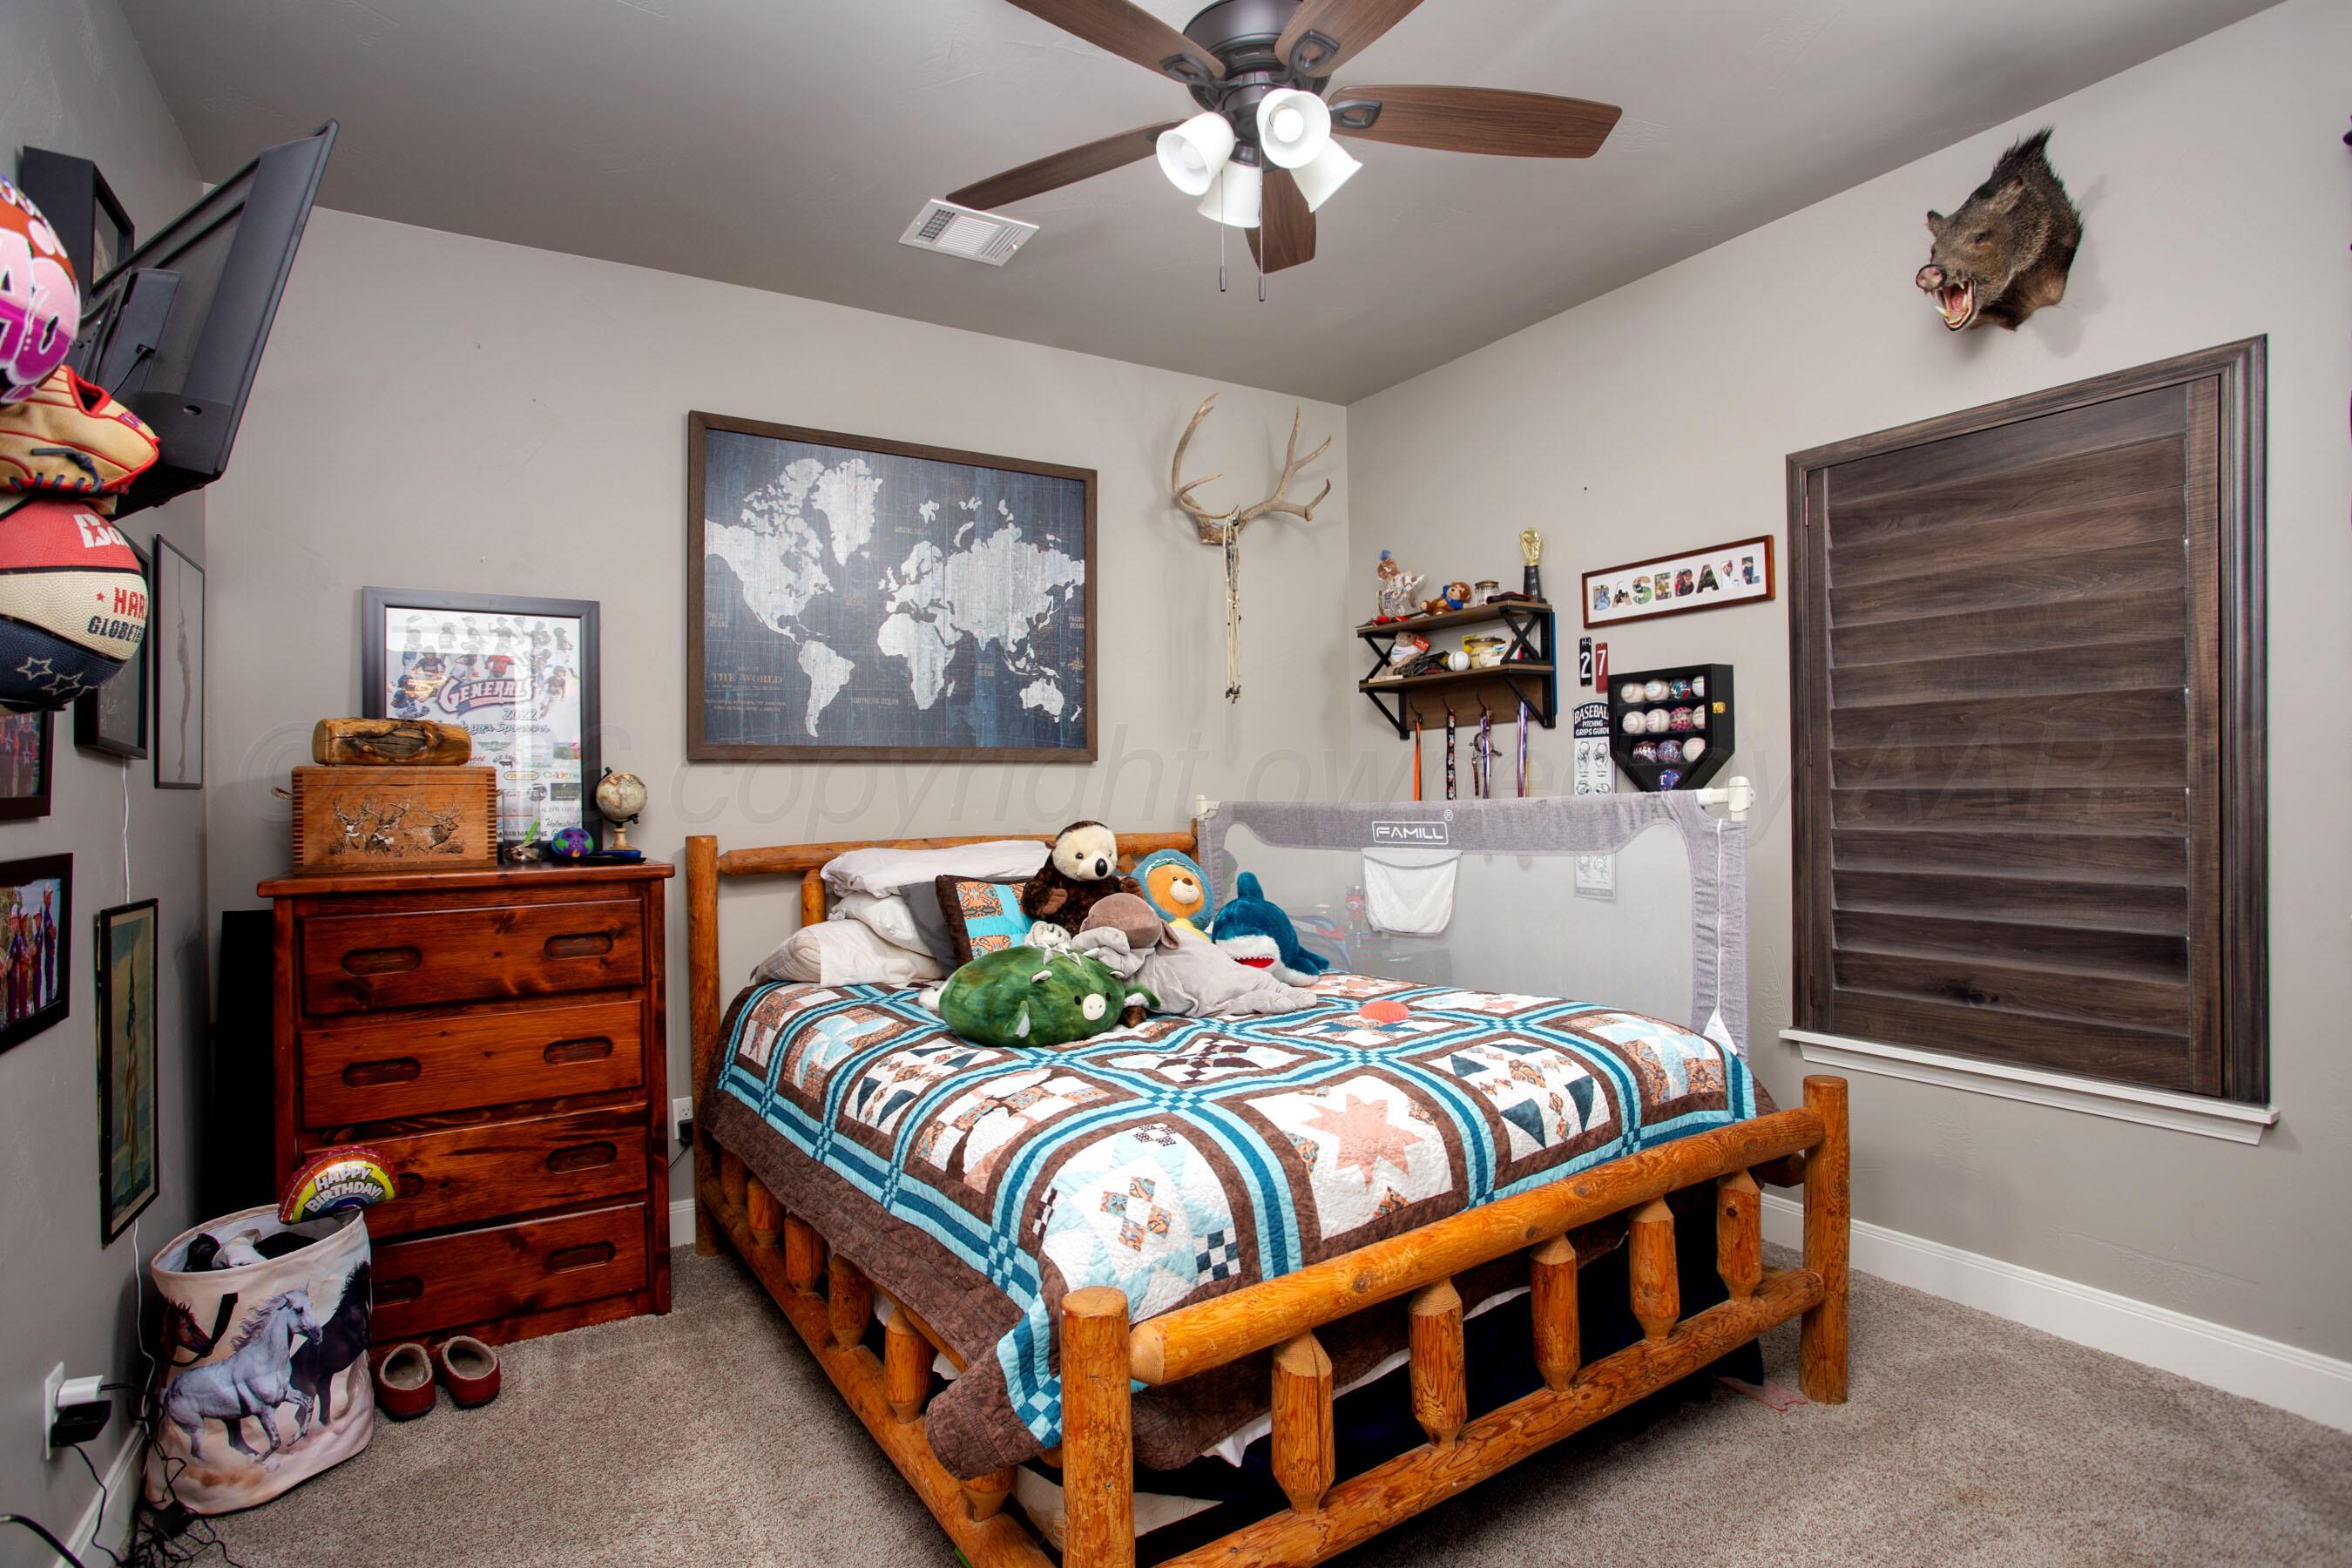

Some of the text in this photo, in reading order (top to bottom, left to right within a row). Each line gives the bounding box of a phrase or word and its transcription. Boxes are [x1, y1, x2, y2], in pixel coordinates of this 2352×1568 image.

[1592, 556, 1760, 611] BASEBALL
[1580, 649, 1606, 679] 2 7
[711, 672, 784, 684] THE WORLD
[502, 708, 538, 720] 2022
[1574, 705, 1609, 725] BASEBAL
[1575, 727, 1592, 737] GRIPS
[1376, 826, 1443, 840] FAMILL
[314, 1165, 373, 1192] HAPPY
[304, 1181, 383, 1213] BIRTHDAY!
